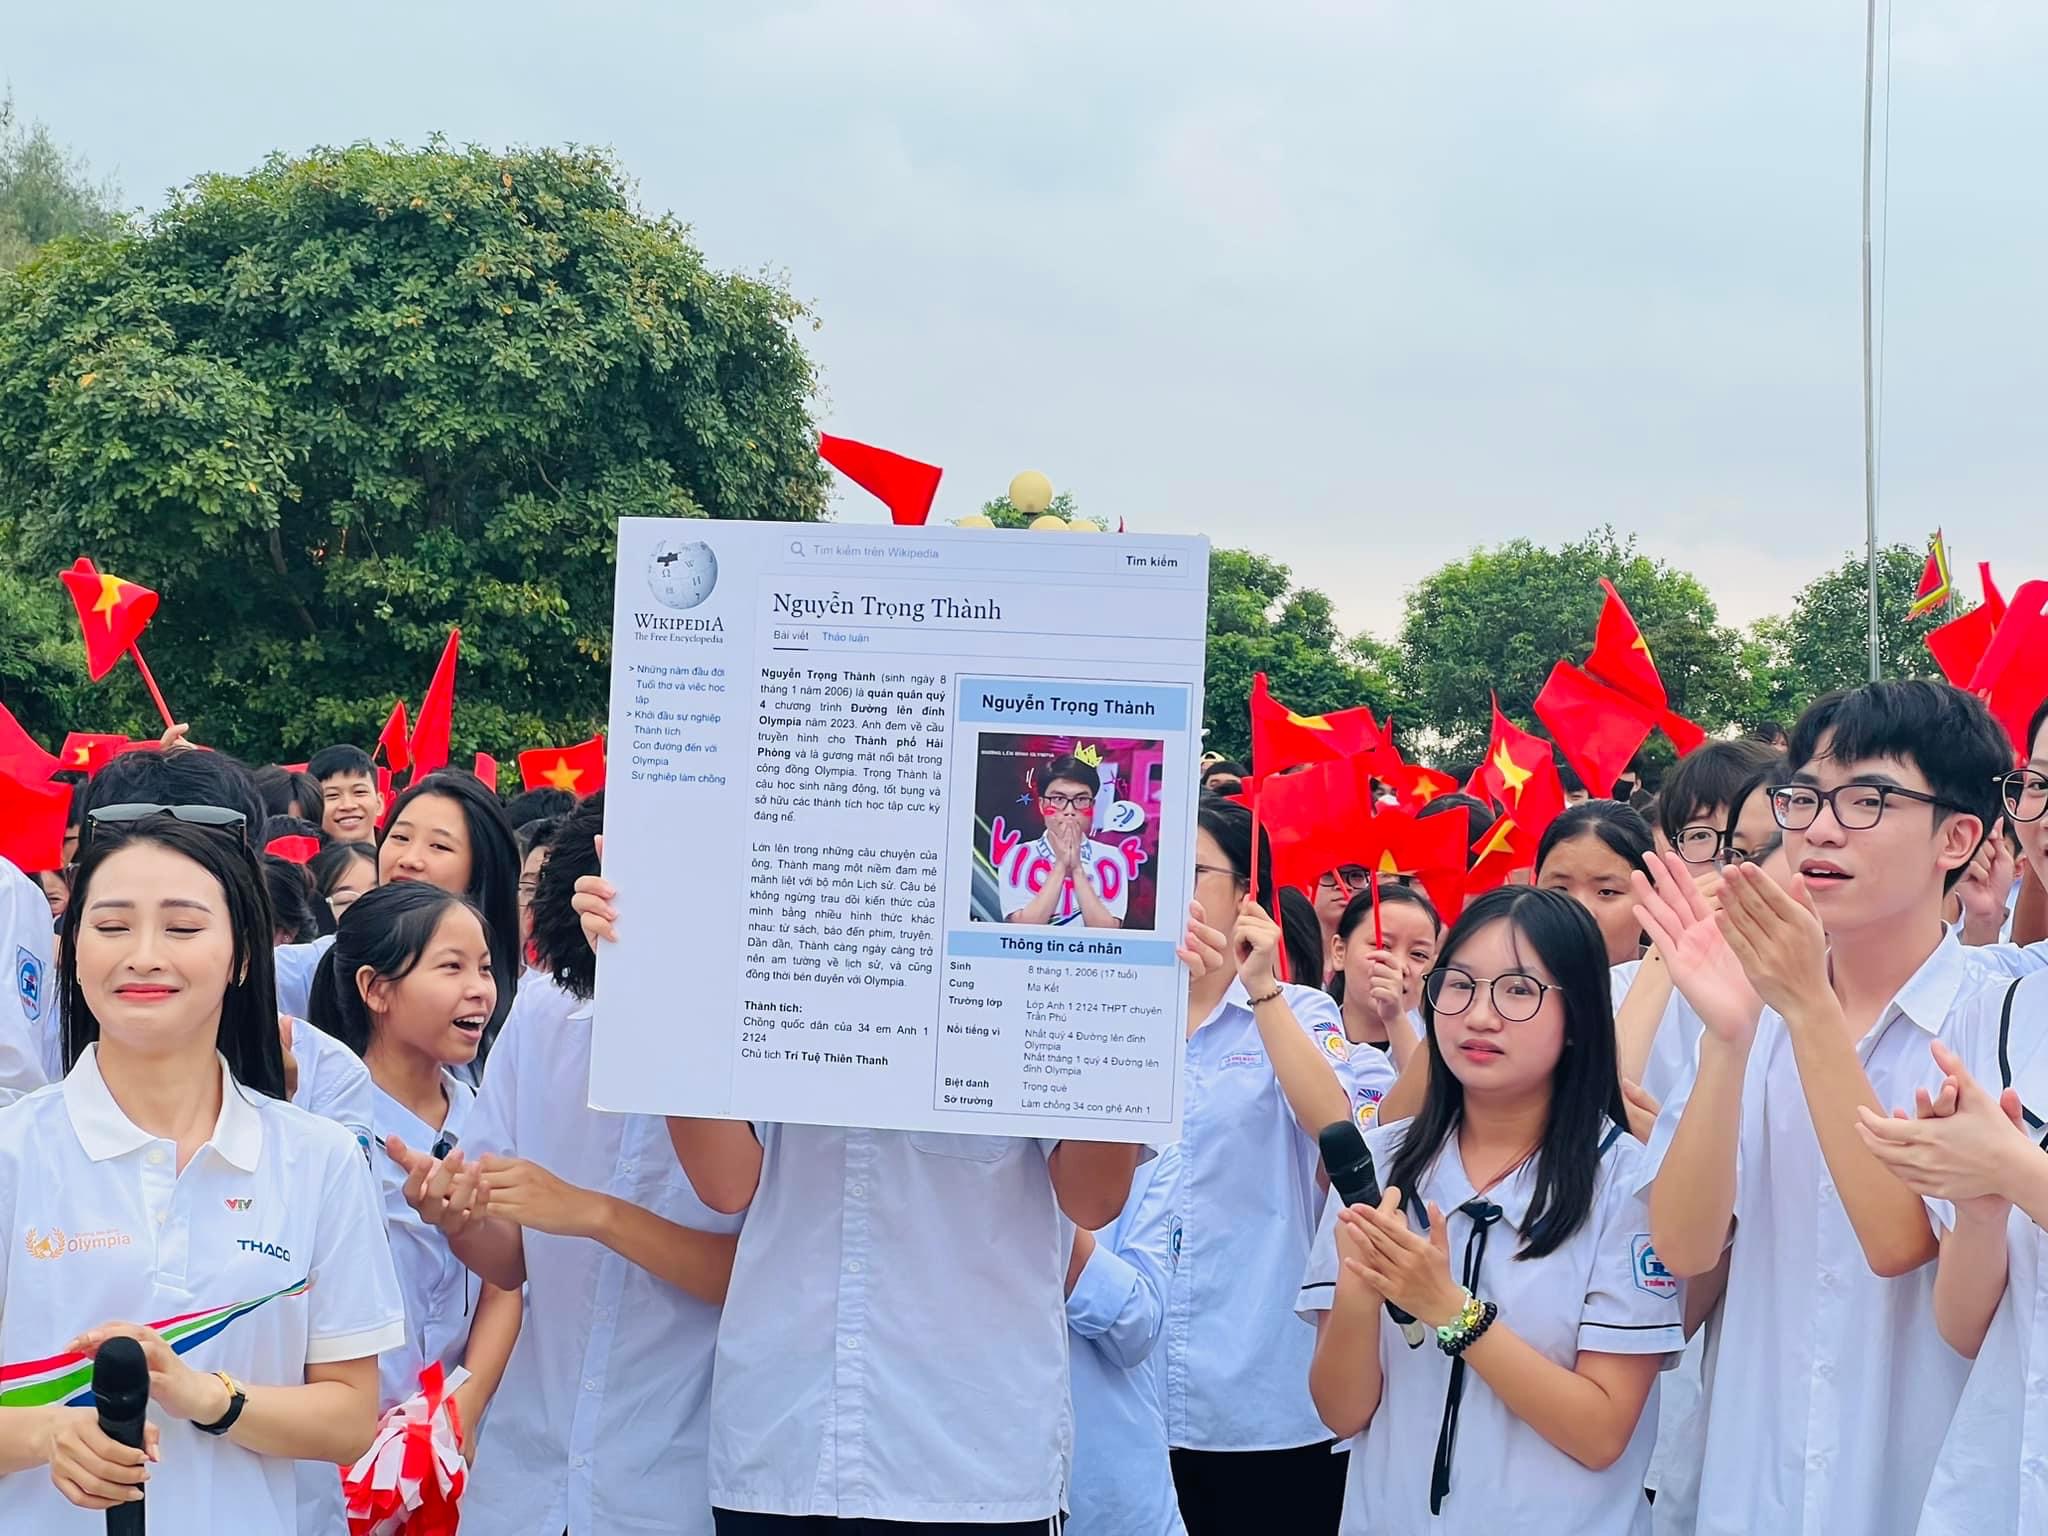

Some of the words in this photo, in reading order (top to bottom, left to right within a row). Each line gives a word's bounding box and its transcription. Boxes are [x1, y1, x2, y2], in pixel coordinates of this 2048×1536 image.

[812, 544, 833, 555] Tìm
[887, 547, 939, 560] Wikipedia
[1125, 555, 1147, 566] Tìm
[772, 589, 854, 618] Nguyễn
[859, 596, 925, 621] Trọng
[930, 596, 1001, 619] Thành
[633, 613, 724, 631] WIKIPEDIA
[634, 631, 648, 640] The
[650, 632, 668, 641] Free
[669, 632, 723, 645] Encyclopedia
[773, 630, 789, 640] Bài
[791, 630, 809, 640] viết
[821, 631, 846, 641] Thảo
[761, 666, 801, 680] Nguyễn
[806, 669, 837, 682] Trọng
[842, 671, 875, 681] Thành
[881, 673, 905, 684] (sinh
[910, 675, 934, 685] ngày
[940, 674, 946, 684] 8
[760, 684, 788, 696] tháng
[791, 685, 796, 694] 1
[800, 685, 821, 695] năm
[824, 686, 852, 698] 2006)
[855, 687, 864, 697] là
[896, 688, 923, 701] quân
[759, 699, 766, 708] 4
[774, 700, 811, 712] chương
[819, 702, 842, 711] trình
[850, 703, 887, 715] Đường
[896, 704, 912, 715] lên
[921, 705, 945, 716] đỉnh
[982, 692, 1044, 713] Nguyễn
[1049, 697, 1098, 716] Trọng
[1103, 699, 1154, 715] Thành
[758, 715, 801, 727] Olympia
[805, 717, 827, 727] năm
[830, 718, 857, 728] 2023.
[861, 719, 881, 729] Anh
[884, 720, 907, 730] đem
[910, 721, 922, 731] về
[926, 721, 944, 732] cầu
[632, 740, 651, 749] Con
[758, 730, 788, 743] truyền
[797, 733, 818, 742] hình
[827, 735, 845, 744] cho
[854, 735, 887, 745] Thành
[896, 735, 917, 748] phố
[926, 737, 943, 748] Hải
[631, 755, 669, 767] Olympia
[757, 746, 791, 759] Phòng
[794, 749, 806, 758] và
[810, 749, 819, 758] là
[822, 751, 853, 761] gương
[857, 751, 875, 761] mặt
[879, 751, 894, 761] nổi
[898, 753, 913, 762] bật
[917, 754, 942, 765] trong
[752, 842, 770, 852] Lớn
[774, 843, 789, 853] lên
[793, 845, 818, 855] trong
[822, 845, 854, 857] những
[857, 847, 876, 857] câu
[879, 848, 915, 859] chuyện
[919, 849, 937, 860] của
[999, 937, 1043, 953] Thông
[1047, 939, 1064, 951] tin
[1068, 940, 1084, 952] cá
[1088, 941, 1122, 954] nhân
[949, 961, 971, 970] Sinh
[948, 978, 974, 990] Cung
[743, 1000, 776, 1011] Thành
[779, 1002, 802, 1013] tích:
[947, 995, 984, 1007] Trường
[986, 998, 1002, 1008] lớp
[743, 1016, 775, 1028] Chồng
[780, 1017, 805, 1030] quốc
[809, 1020, 829, 1030] dân
[834, 1021, 852, 1031] của
[857, 1022, 870, 1032] 34
[875, 1026, 891, 1034] em
[896, 1025, 917, 1035] Anh
[923, 1026, 927, 1035] 1
[946, 1022, 963, 1033] Nổi
[965, 1023, 989, 1037] tiếng
[991, 1027, 1000, 1035] vì
[741, 1031, 766, 1043] 2124
[741, 1047, 761, 1058] Chủ
[764, 1049, 781, 1059] tịch
[783, 1050, 798, 1060] Trí
[800, 1051, 820, 1063] Tuệ
[823, 1052, 852, 1063] Thiên
[855, 1054, 888, 1065] Thanh
[944, 1077, 963, 1088] Biệt
[965, 1078, 989, 1088] danh
[943, 1094, 957, 1103] Sở
[959, 1096, 993, 1107] trường
[225, 1199, 252, 1211] VTV
[67, 1234, 131, 1253] Olympia
[236, 1239, 291, 1262] THACO
